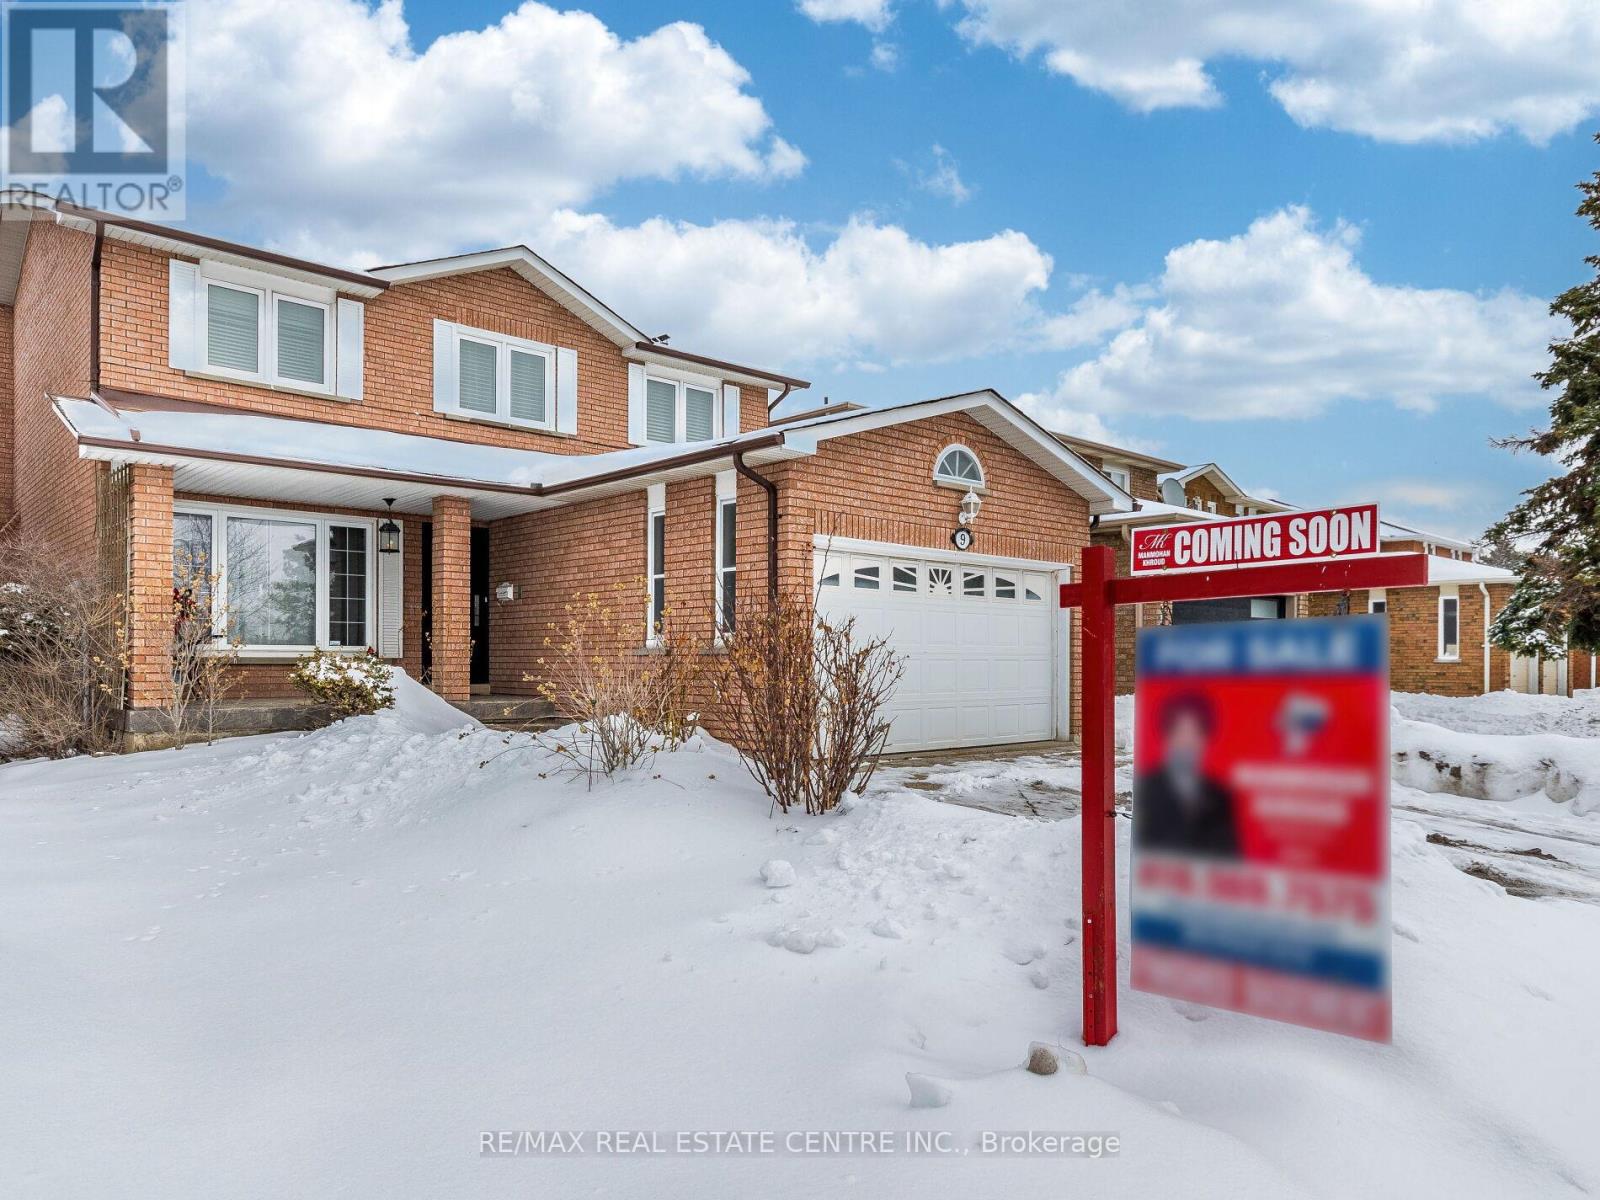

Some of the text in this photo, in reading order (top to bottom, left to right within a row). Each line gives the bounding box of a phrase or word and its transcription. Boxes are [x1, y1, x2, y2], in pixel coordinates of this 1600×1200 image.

[960, 533, 966, 546] 9
[1174, 510, 1371, 565] COMING SOON
